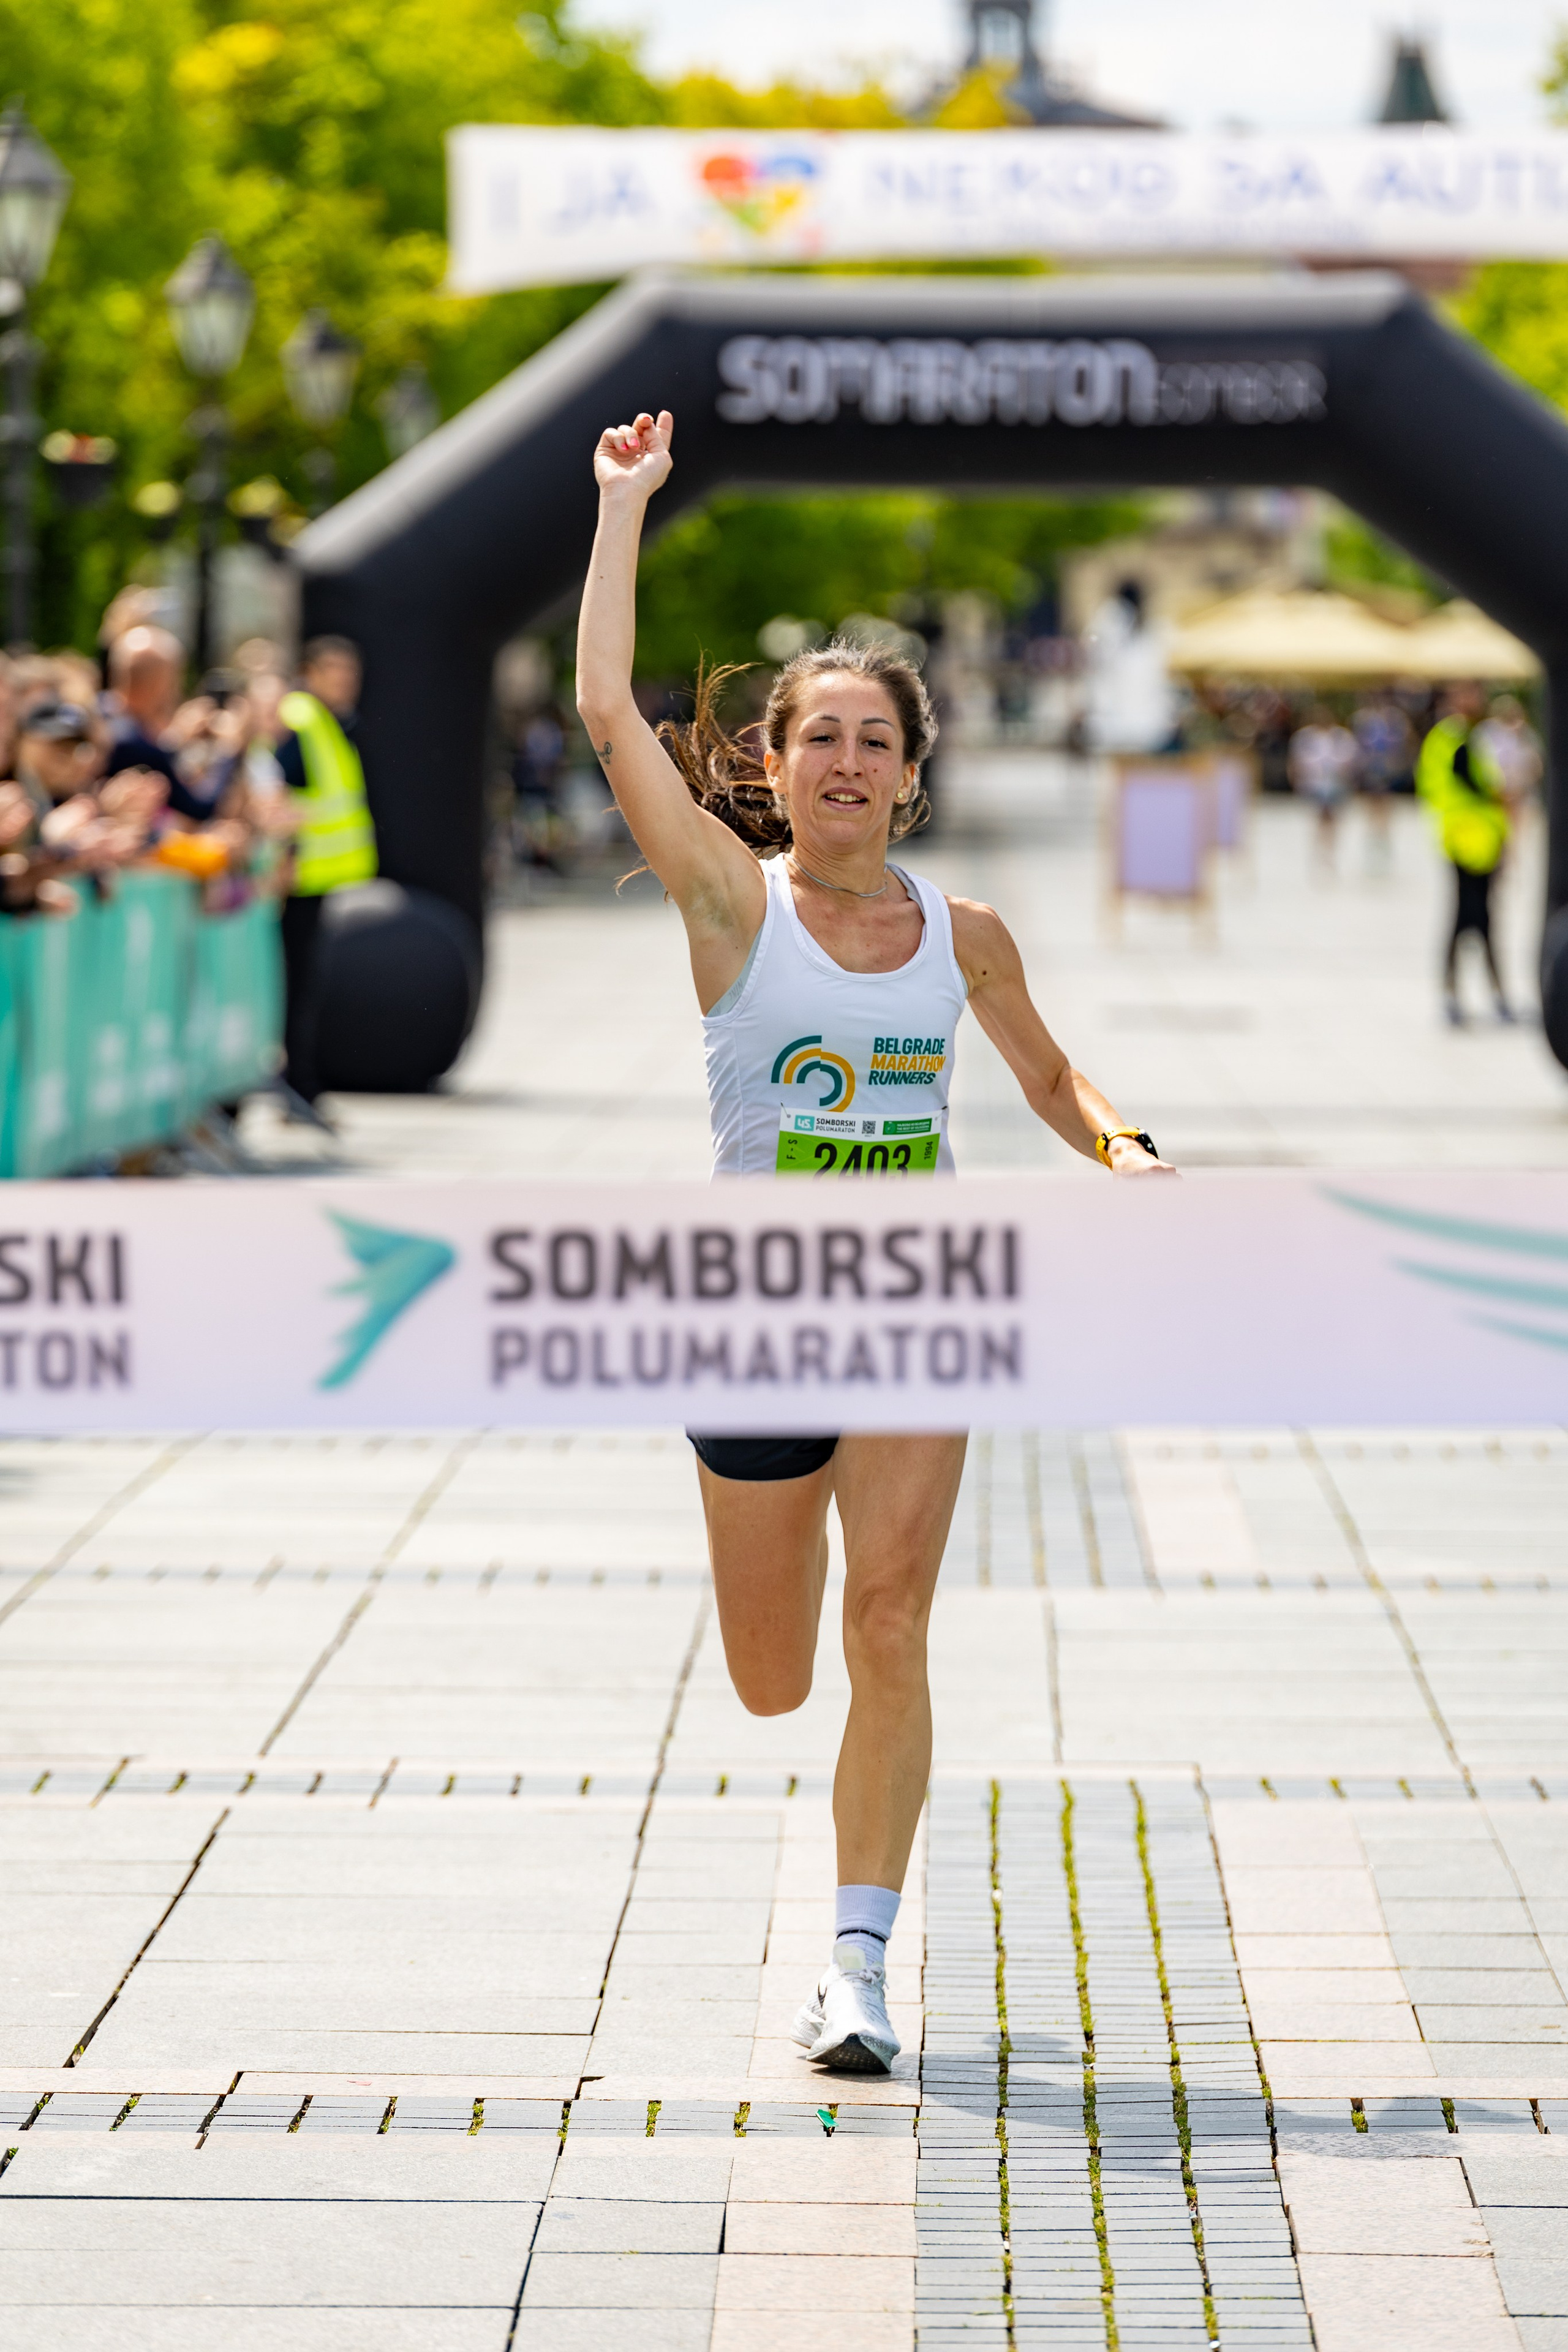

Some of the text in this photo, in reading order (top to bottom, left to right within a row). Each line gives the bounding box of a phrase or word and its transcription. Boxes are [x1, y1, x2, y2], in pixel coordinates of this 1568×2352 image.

[873, 1037, 946, 1055] BELGRADE
[870, 1054, 946, 1072] MARATHON
[868, 1070, 937, 1085] RUNNERS
[816, 1118, 856, 1127] SOMBORSKI
[924, 1140, 933, 1160] 1994
[812, 1142, 911, 1182] 2403
[491, 1227, 1019, 1303] SOMBORSKI
[492, 1324, 1022, 1387] POLUMARATON
